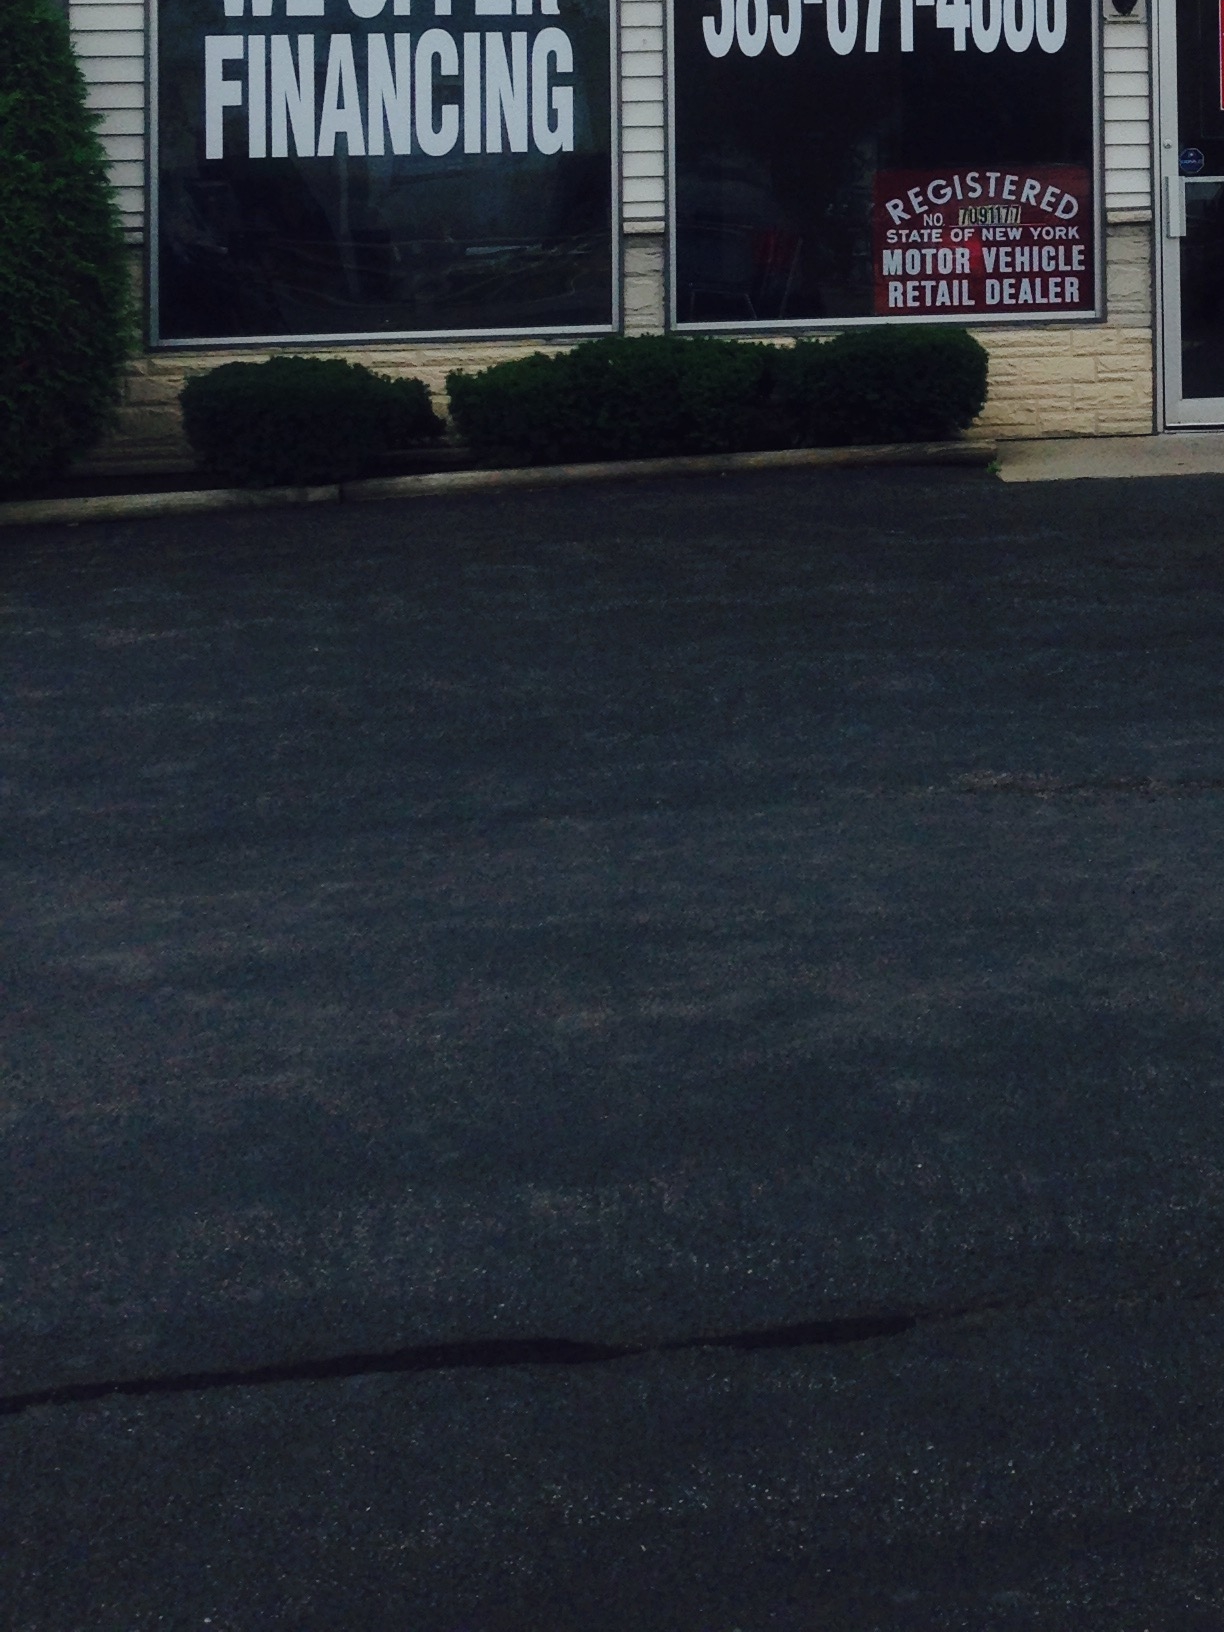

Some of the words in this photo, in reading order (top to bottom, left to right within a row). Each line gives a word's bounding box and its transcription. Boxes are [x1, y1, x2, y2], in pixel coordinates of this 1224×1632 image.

[204, 27, 575, 160] FINANCING
[885, 171, 1079, 225] REGISTERED
[959, 205, 1021, 225] 7091177
[886, 229, 943, 243] STATE
[950, 228, 975, 242] OF
[982, 227, 1023, 241] NEW
[1029, 225, 1080, 240] YORK
[882, 247, 971, 276] MOTOR
[982, 244, 1086, 273] VEHICLE
[888, 279, 976, 308] RETAIL
[985, 276, 1080, 304] DEALER
